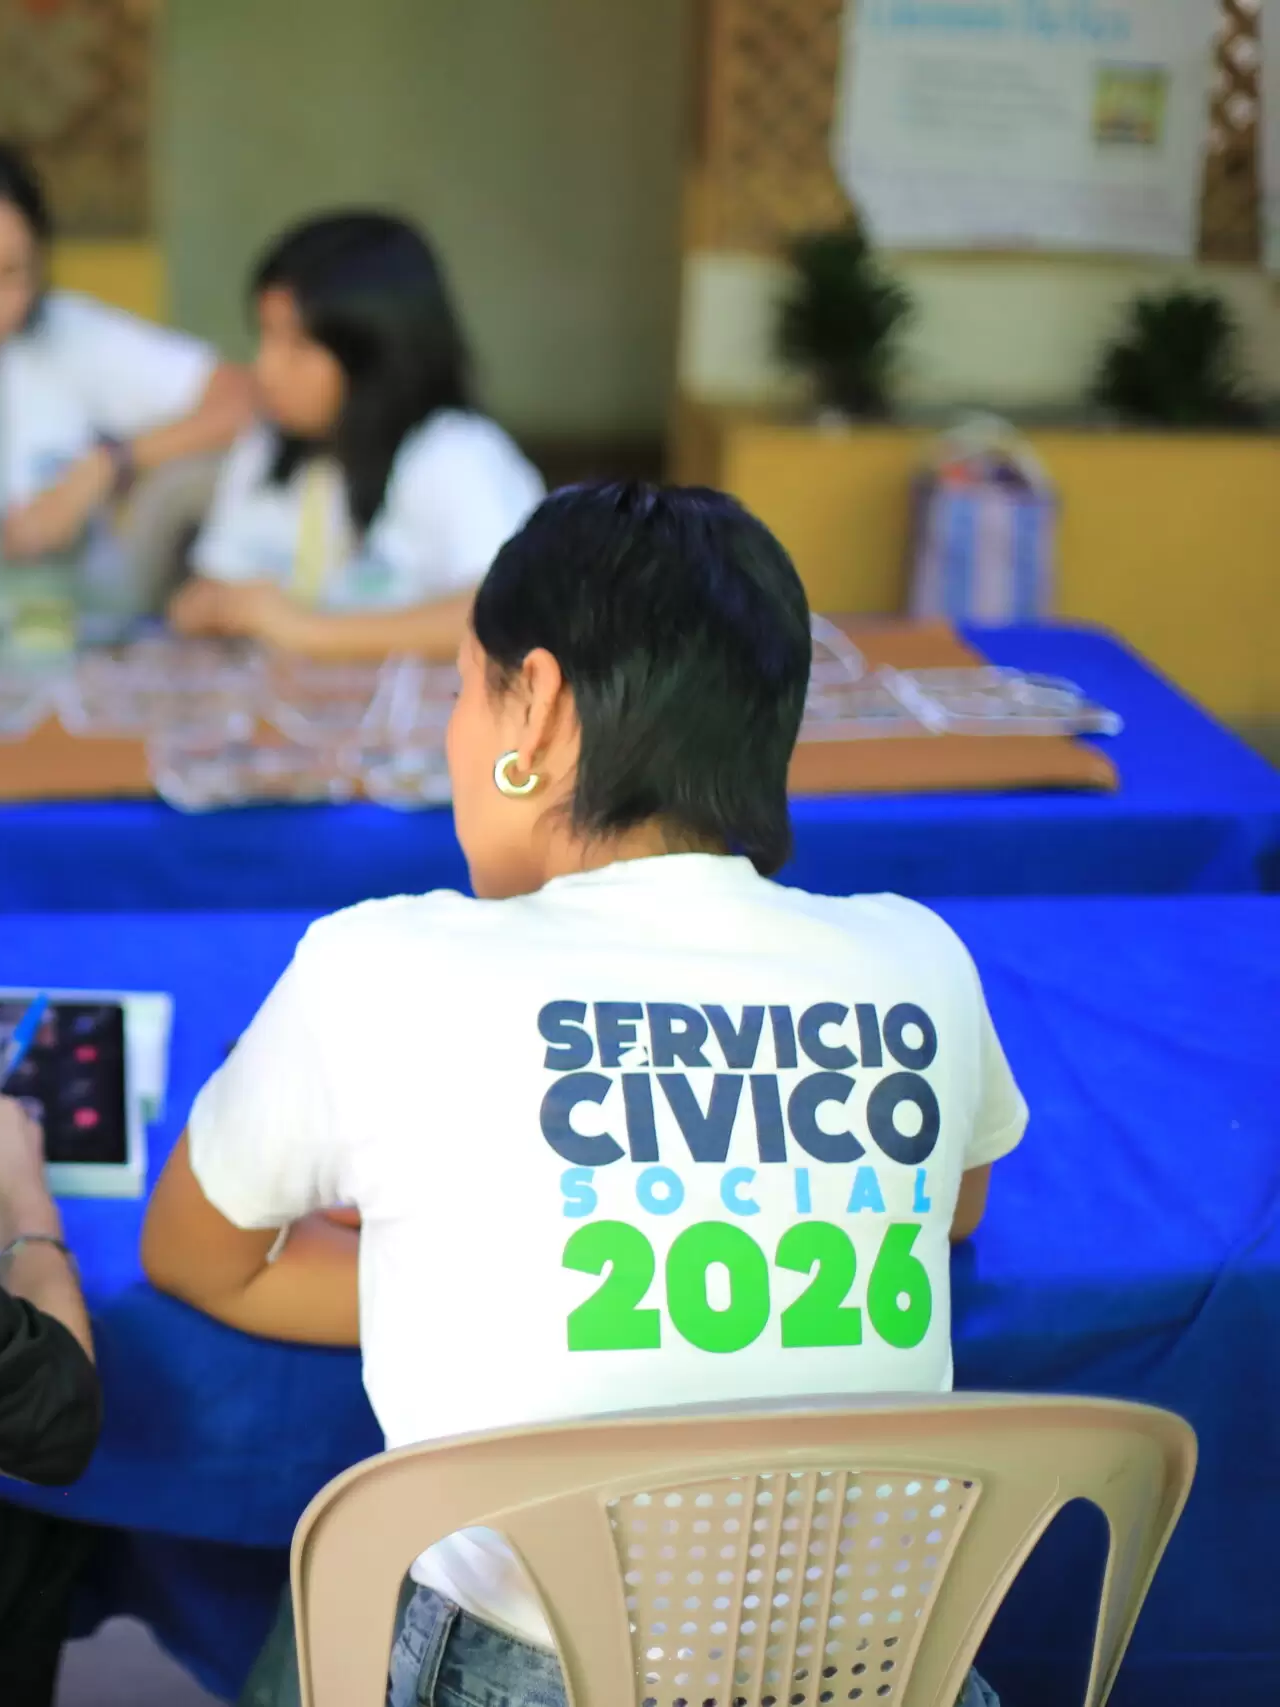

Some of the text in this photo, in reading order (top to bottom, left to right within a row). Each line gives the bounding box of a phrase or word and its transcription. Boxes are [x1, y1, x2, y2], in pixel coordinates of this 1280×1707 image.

[537, 1000, 938, 1071] SERVICIO
[560, 1166, 931, 1219] SOCIAL
[561, 1219, 932, 1354] 2026
